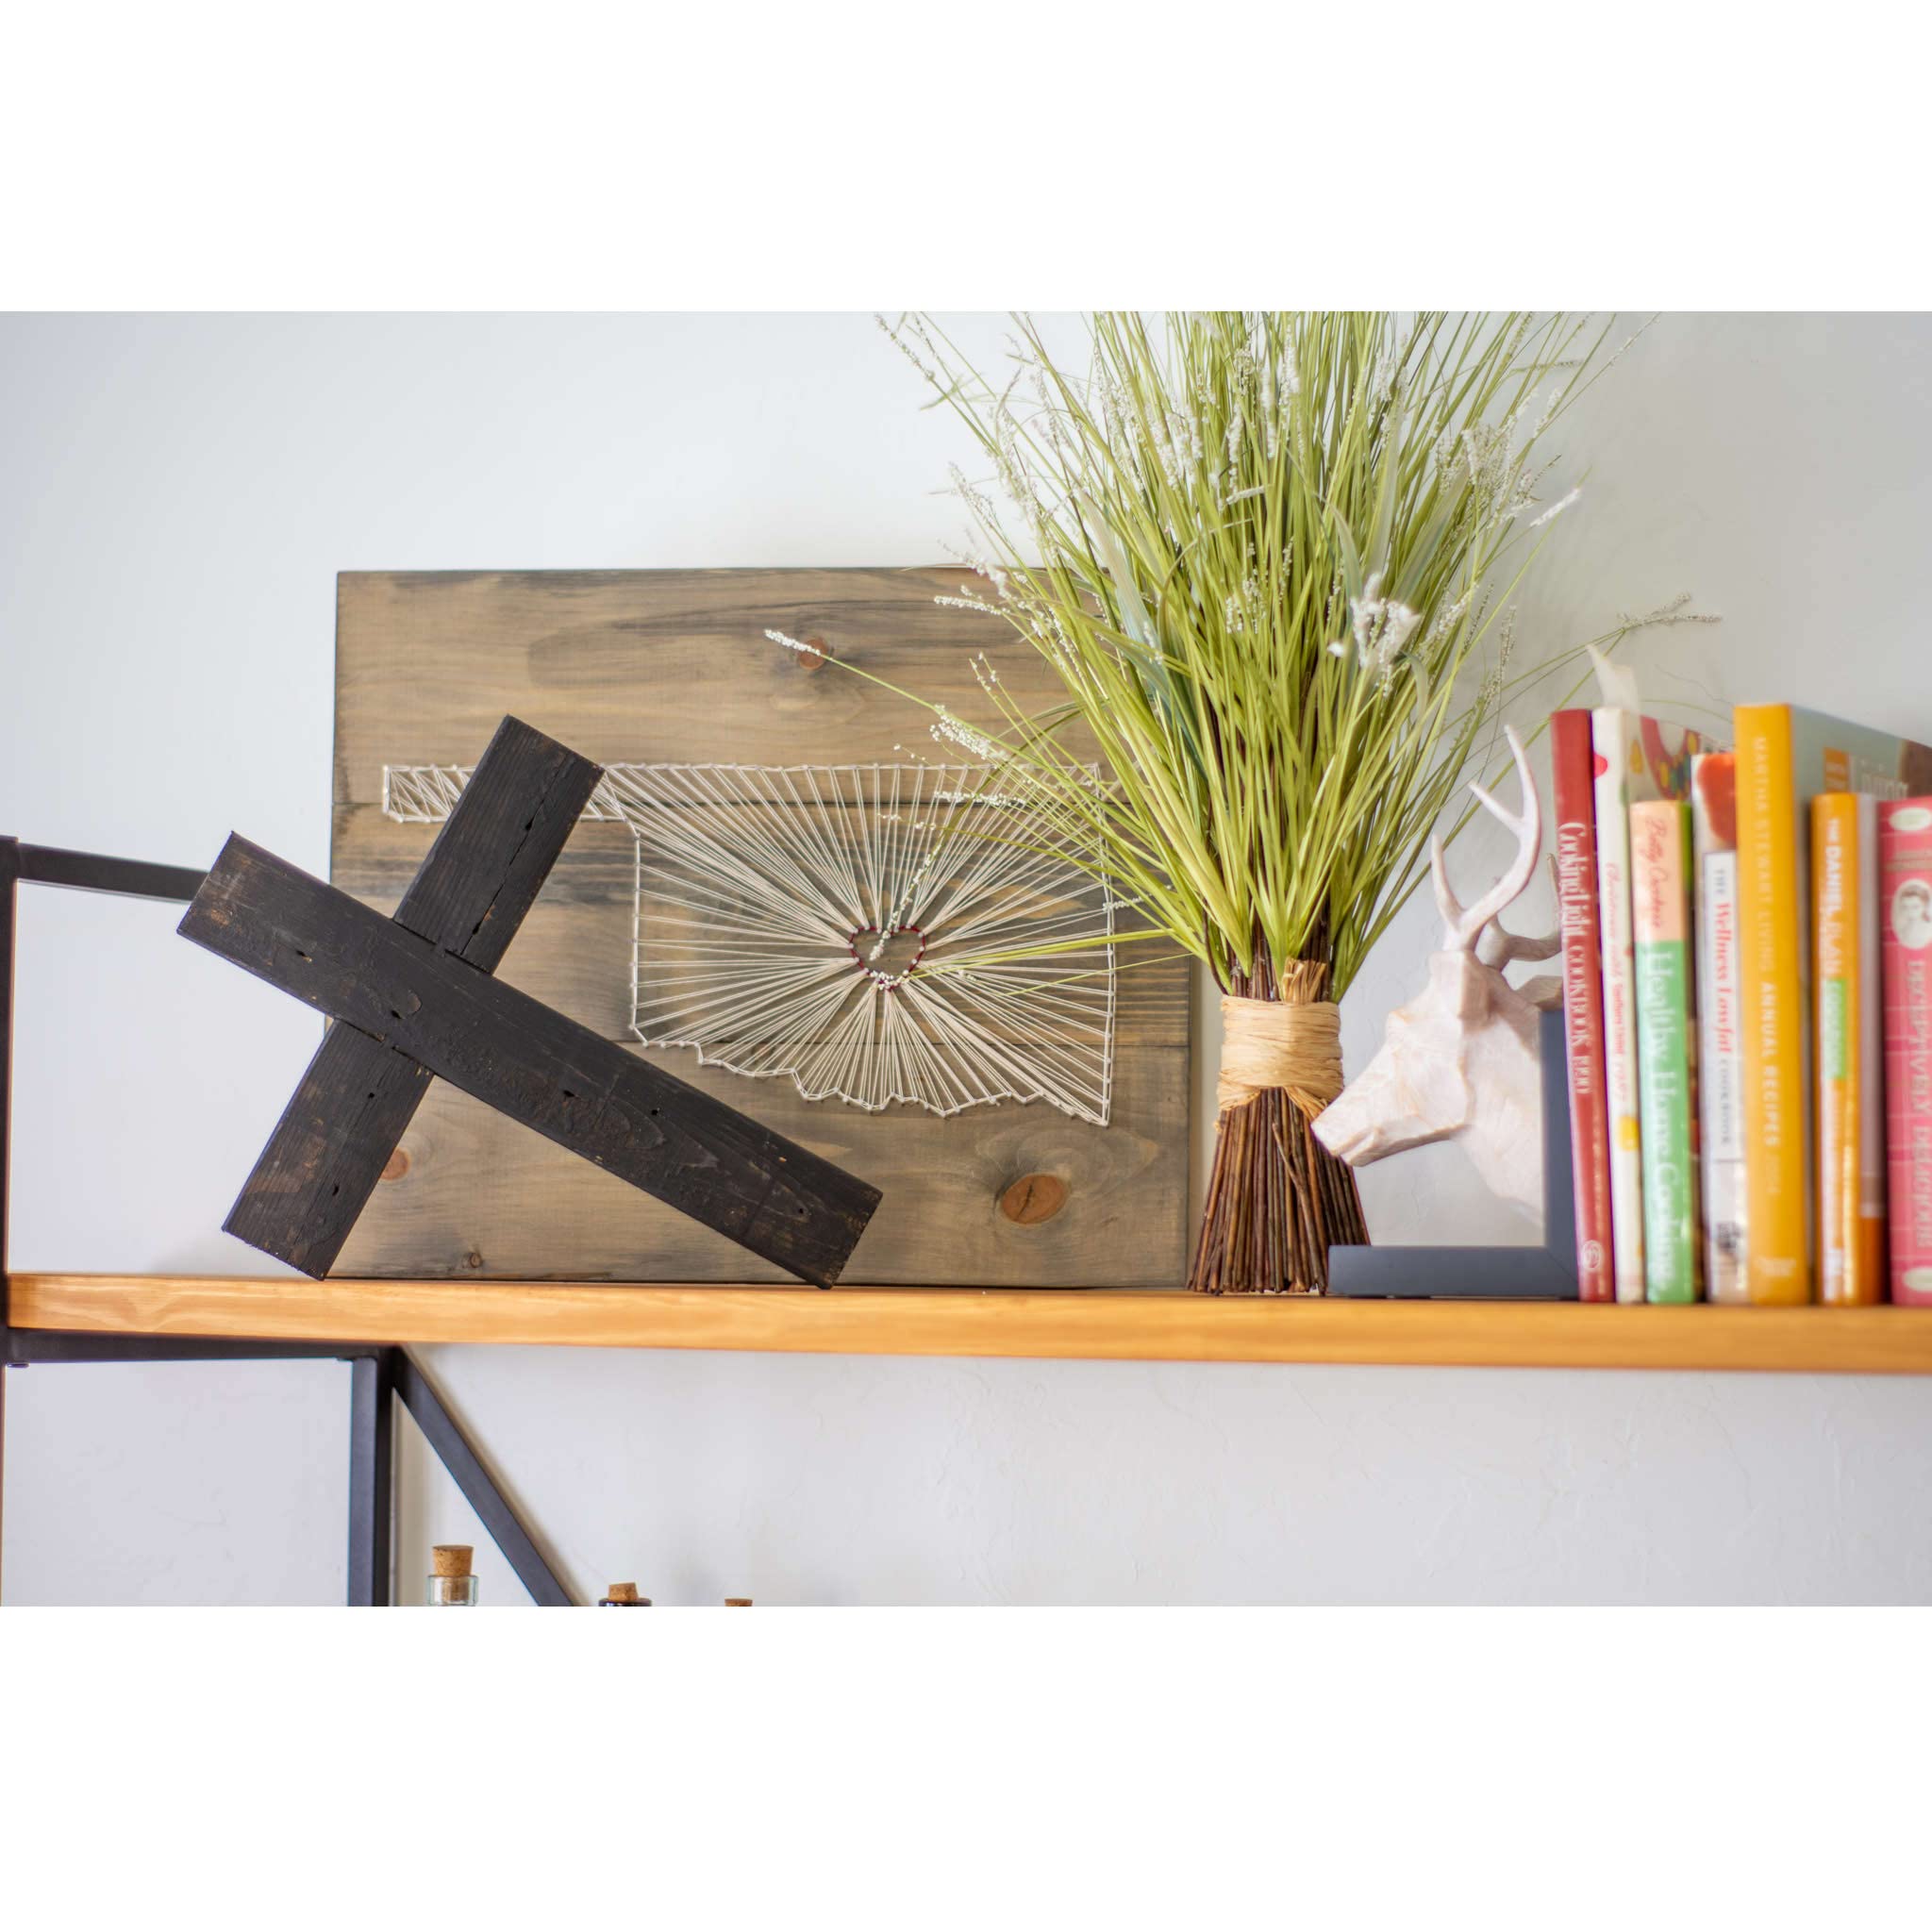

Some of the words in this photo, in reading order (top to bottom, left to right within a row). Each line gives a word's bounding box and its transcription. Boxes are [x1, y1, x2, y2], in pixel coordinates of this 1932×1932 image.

[1557, 822, 1589, 894] Cooking
[1825, 845, 1842, 917] DANIEL
[1560, 894, 1591, 938] Light
[1715, 902, 1732, 981] Wellness
[1568, 944, 1591, 1048] COOKBOOK
[1645, 951, 1676, 1060] Healthy
[1714, 987, 1734, 1054] Lowfat
[1760, 981, 1778, 1058] ANNUAL
[1907, 959, 1932, 1115] DECEPTIVELY
[1650, 1073, 1678, 1158] Home
[1762, 1065, 1781, 1147] RECIPES
